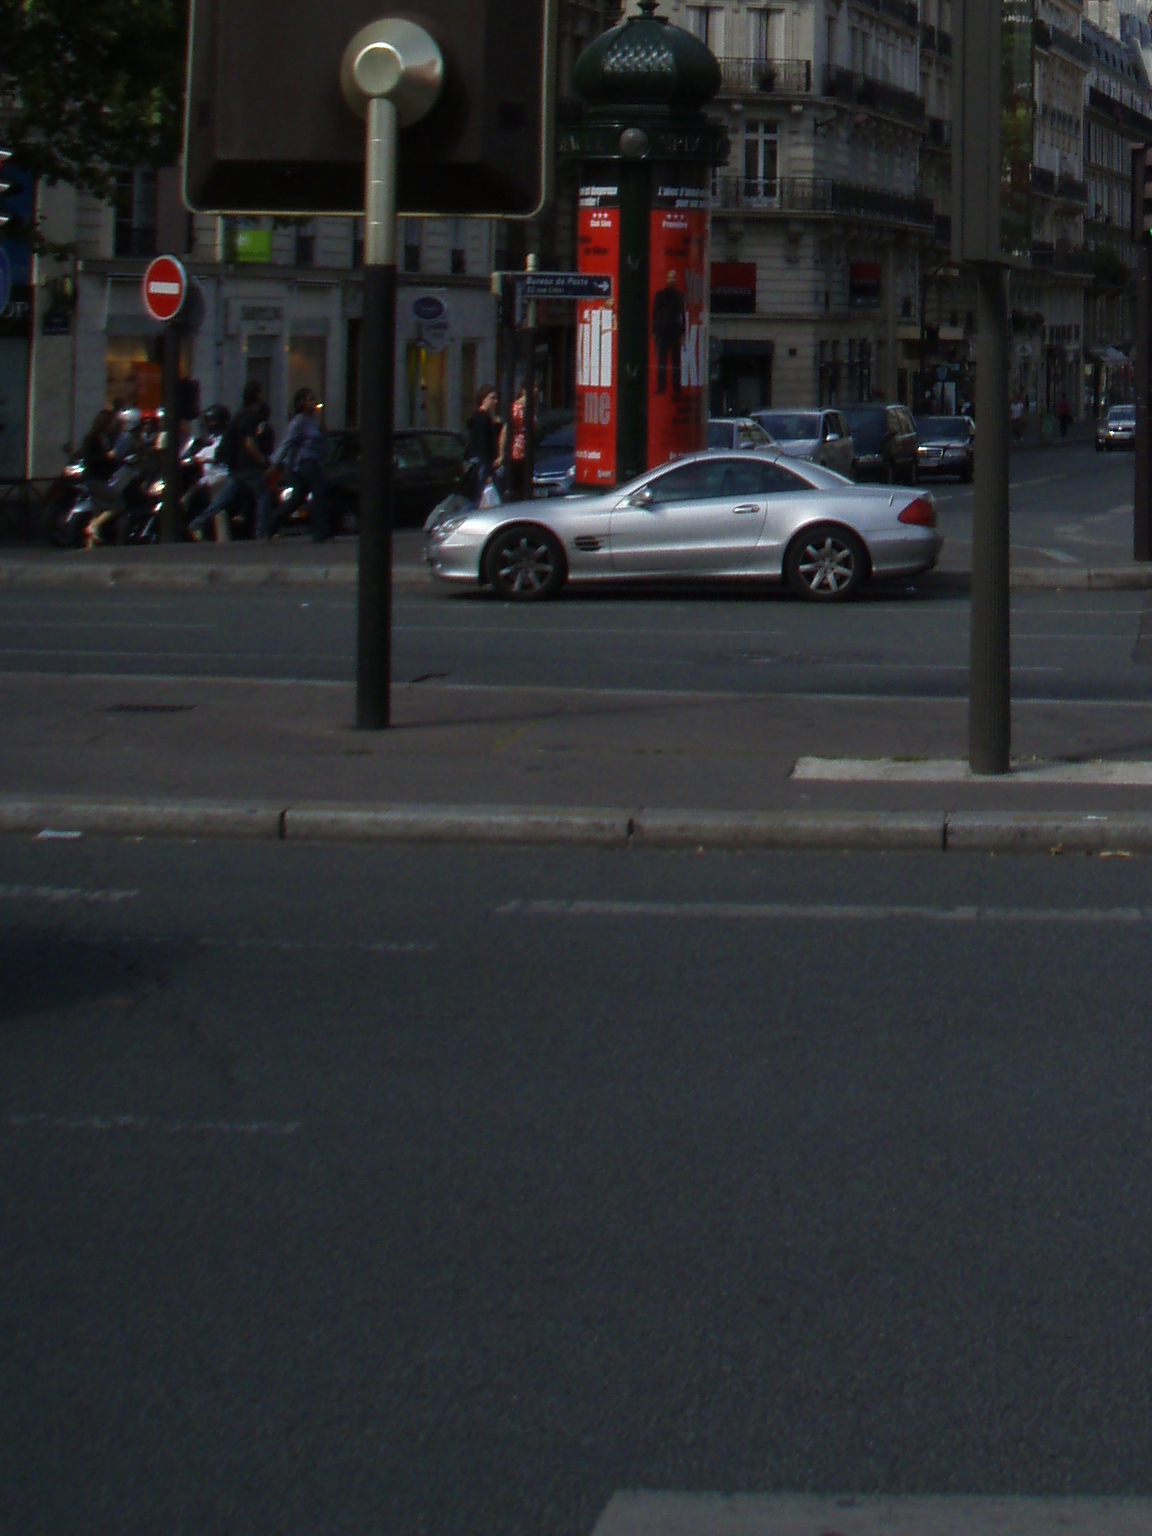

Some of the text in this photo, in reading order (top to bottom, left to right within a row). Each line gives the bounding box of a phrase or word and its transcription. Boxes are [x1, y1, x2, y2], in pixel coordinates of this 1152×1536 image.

[526, 276, 589, 286] Bureau de Poste
